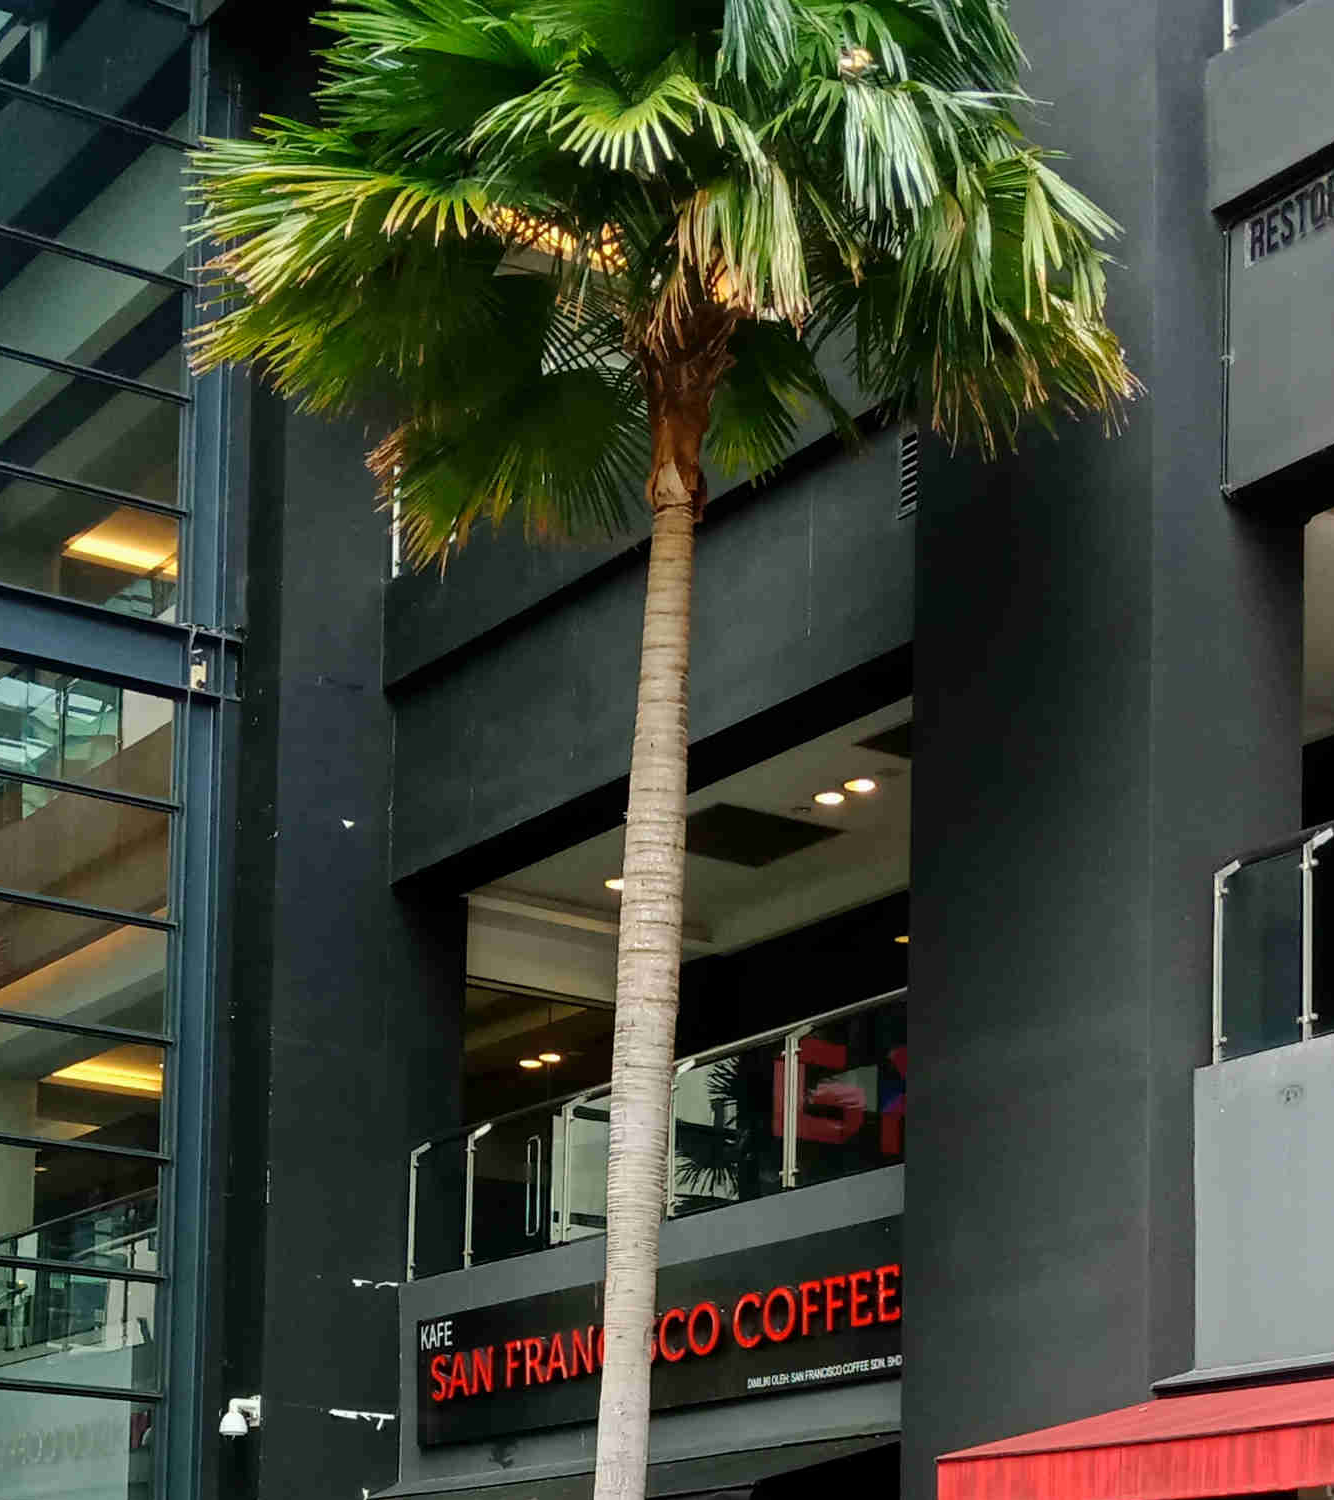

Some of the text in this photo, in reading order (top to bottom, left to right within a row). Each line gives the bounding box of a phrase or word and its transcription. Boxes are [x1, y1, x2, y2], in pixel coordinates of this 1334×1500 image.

[420, 1320, 453, 1350] KAFE
[431, 1263, 901, 1402] SAN FRANCO COFFEE
